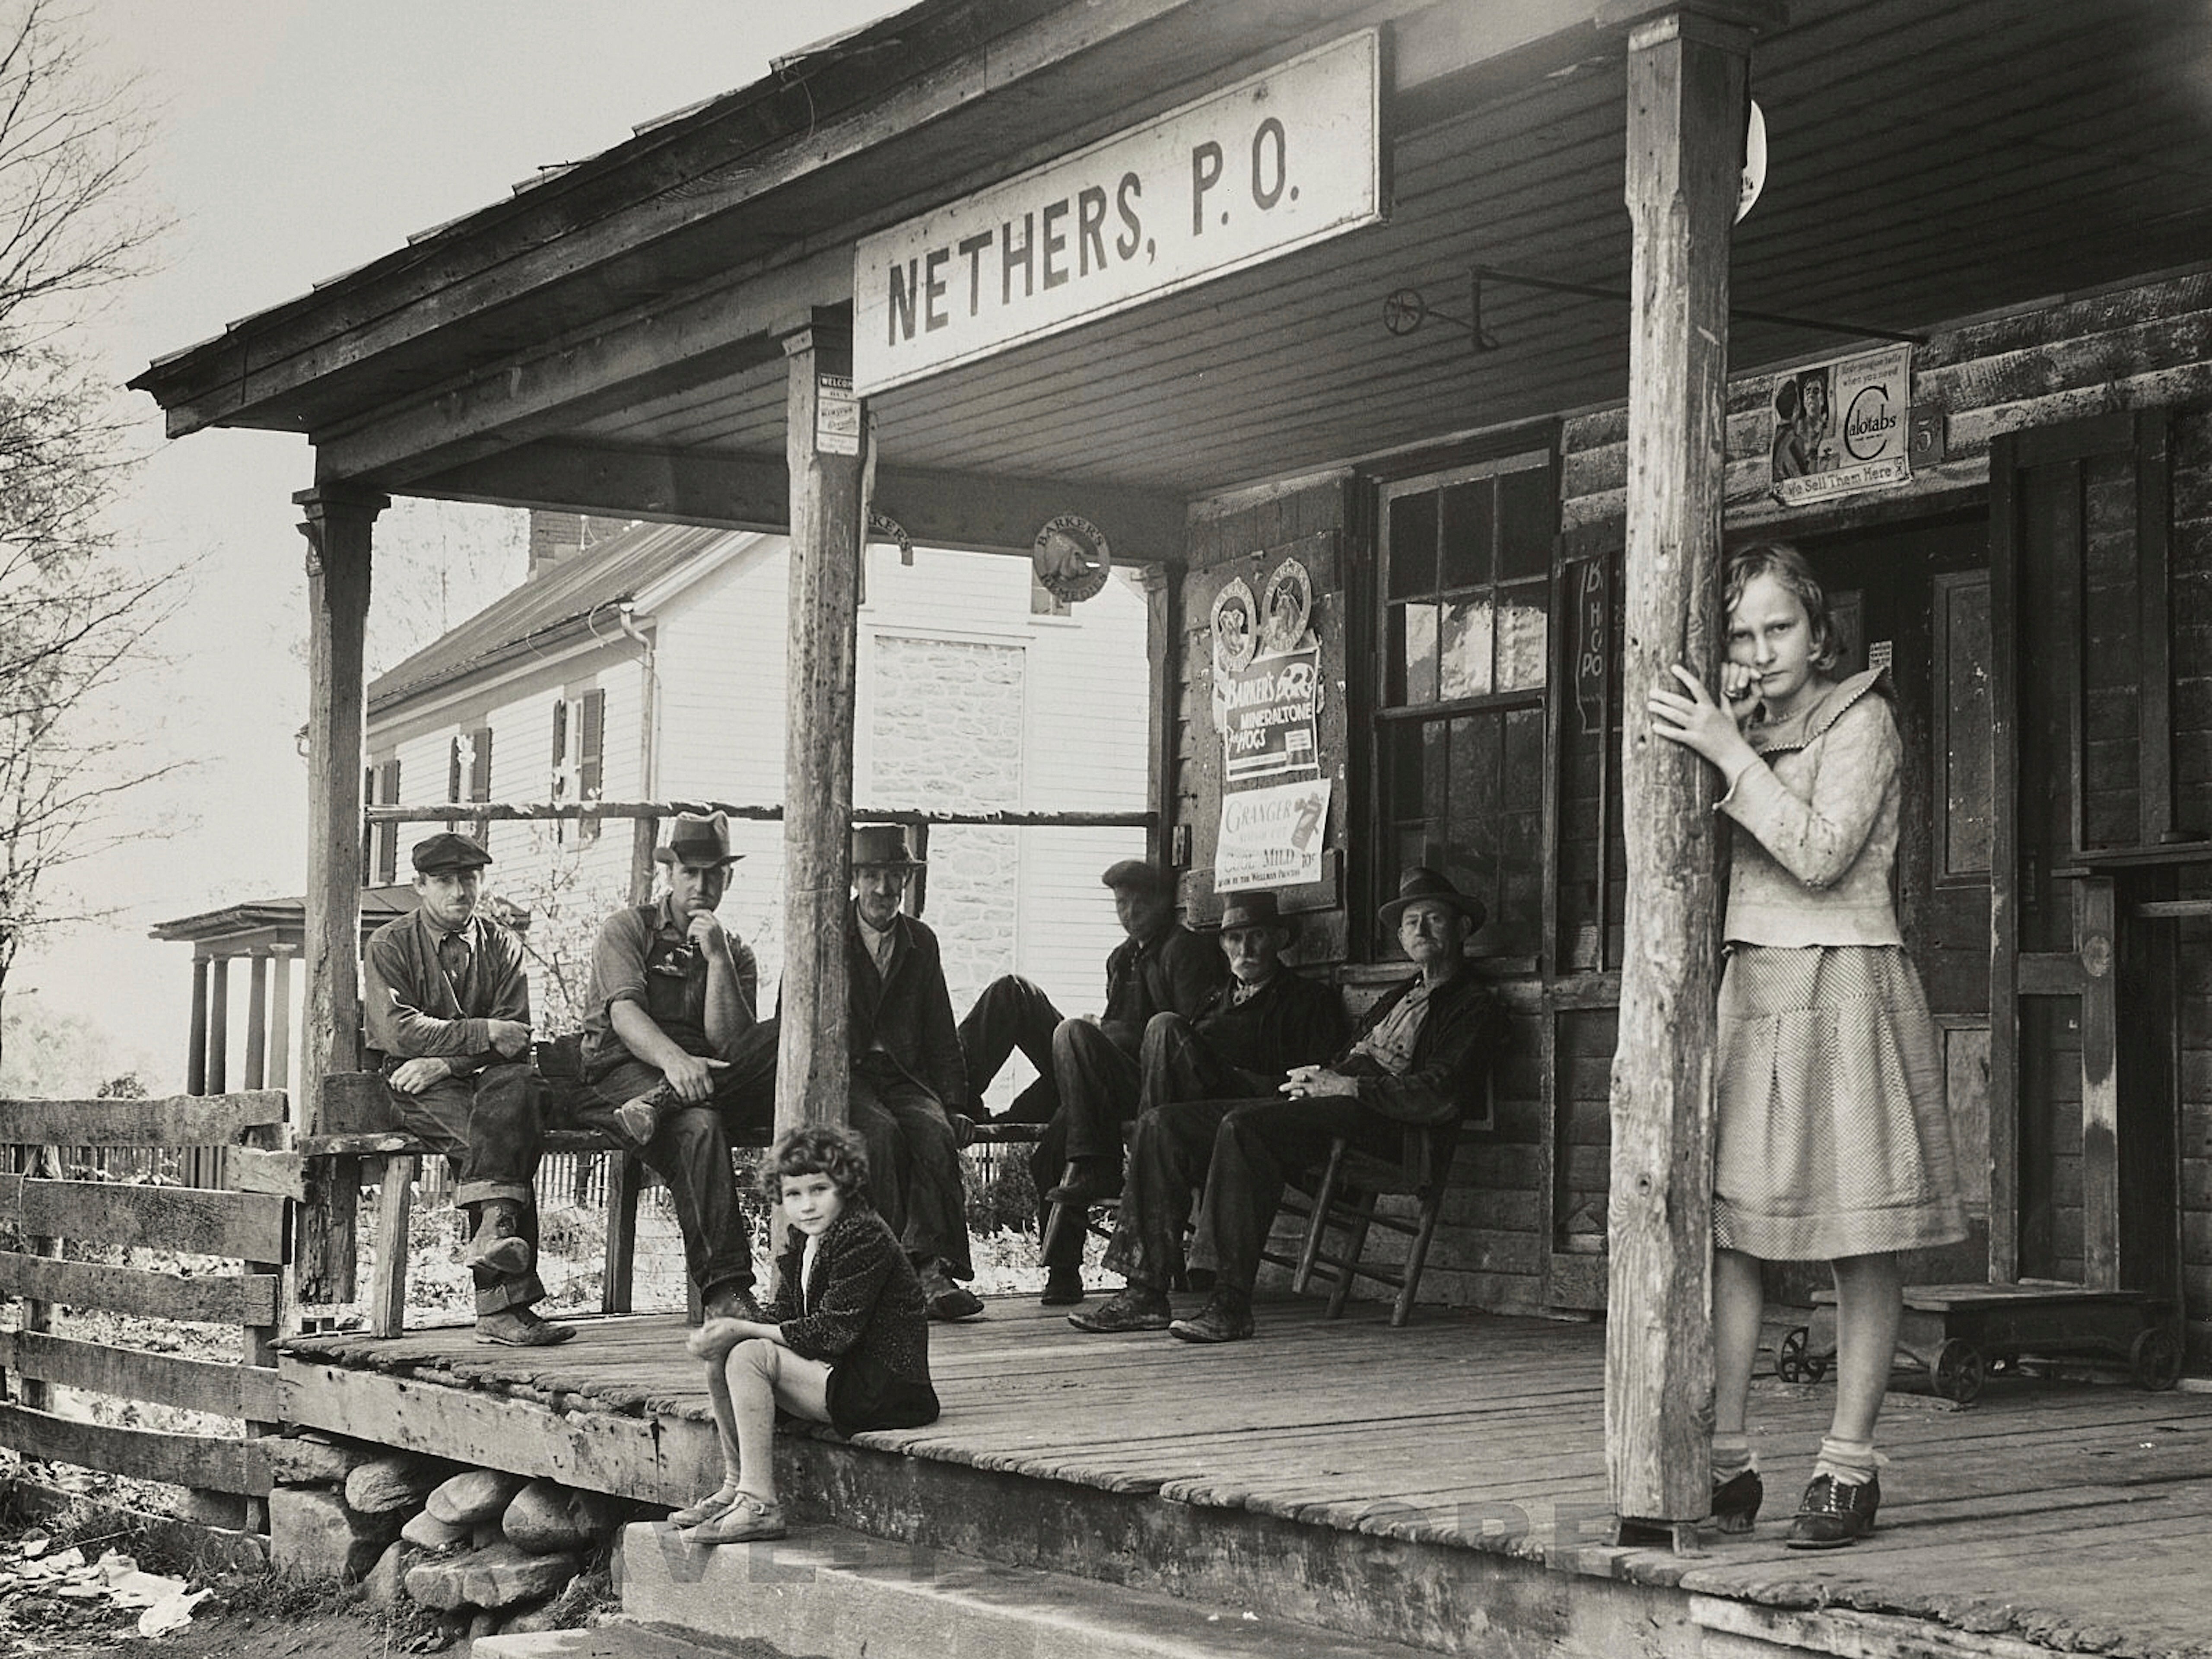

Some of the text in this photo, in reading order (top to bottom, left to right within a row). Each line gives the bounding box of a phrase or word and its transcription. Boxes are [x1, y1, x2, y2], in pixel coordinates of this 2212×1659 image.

[889, 172, 1156, 346] NETHERS,
[1844, 384, 1897, 461] Calotabs
[1805, 477, 1826, 491] Sell
[1830, 472, 1860, 487] Them
[1863, 467, 1891, 480] Here
[1038, 517, 1103, 546] BARKER'S
[1228, 671, 1274, 709] BARKER'S
[1240, 702, 1313, 737] MINERALTONE
[1237, 728, 1266, 753] HOGS
[1226, 799, 1292, 833] GRANGER
[1263, 849, 1295, 868] MILD
